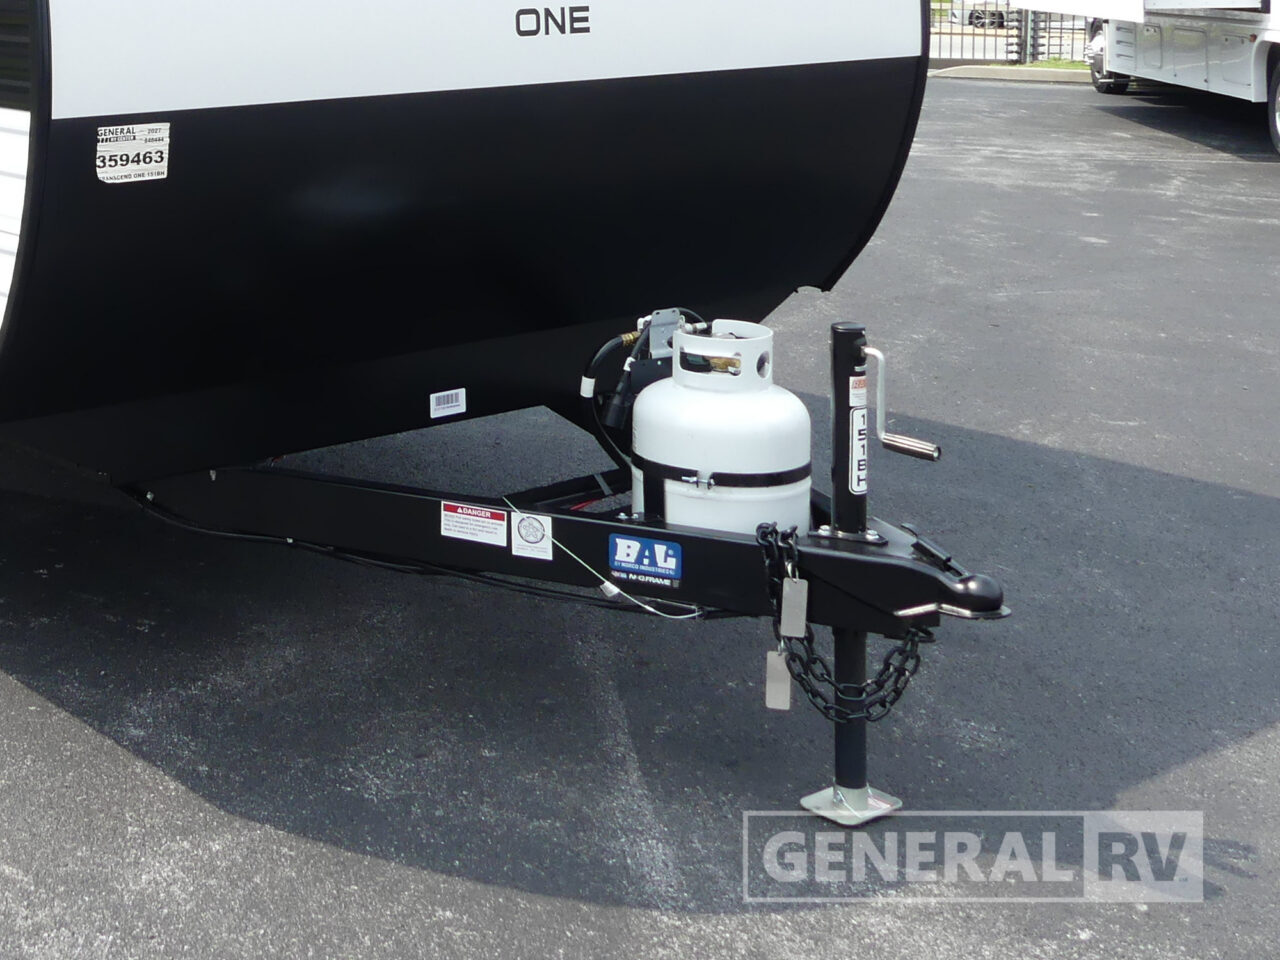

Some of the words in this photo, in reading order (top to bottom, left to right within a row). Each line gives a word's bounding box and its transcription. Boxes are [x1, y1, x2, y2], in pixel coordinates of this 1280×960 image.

[515, 5, 591, 37] ONE
[98, 126, 136, 137] GENERAL
[96, 150, 165, 169] 359463
[462, 507, 492, 519] DANGER
[614, 538, 677, 570] BAL
